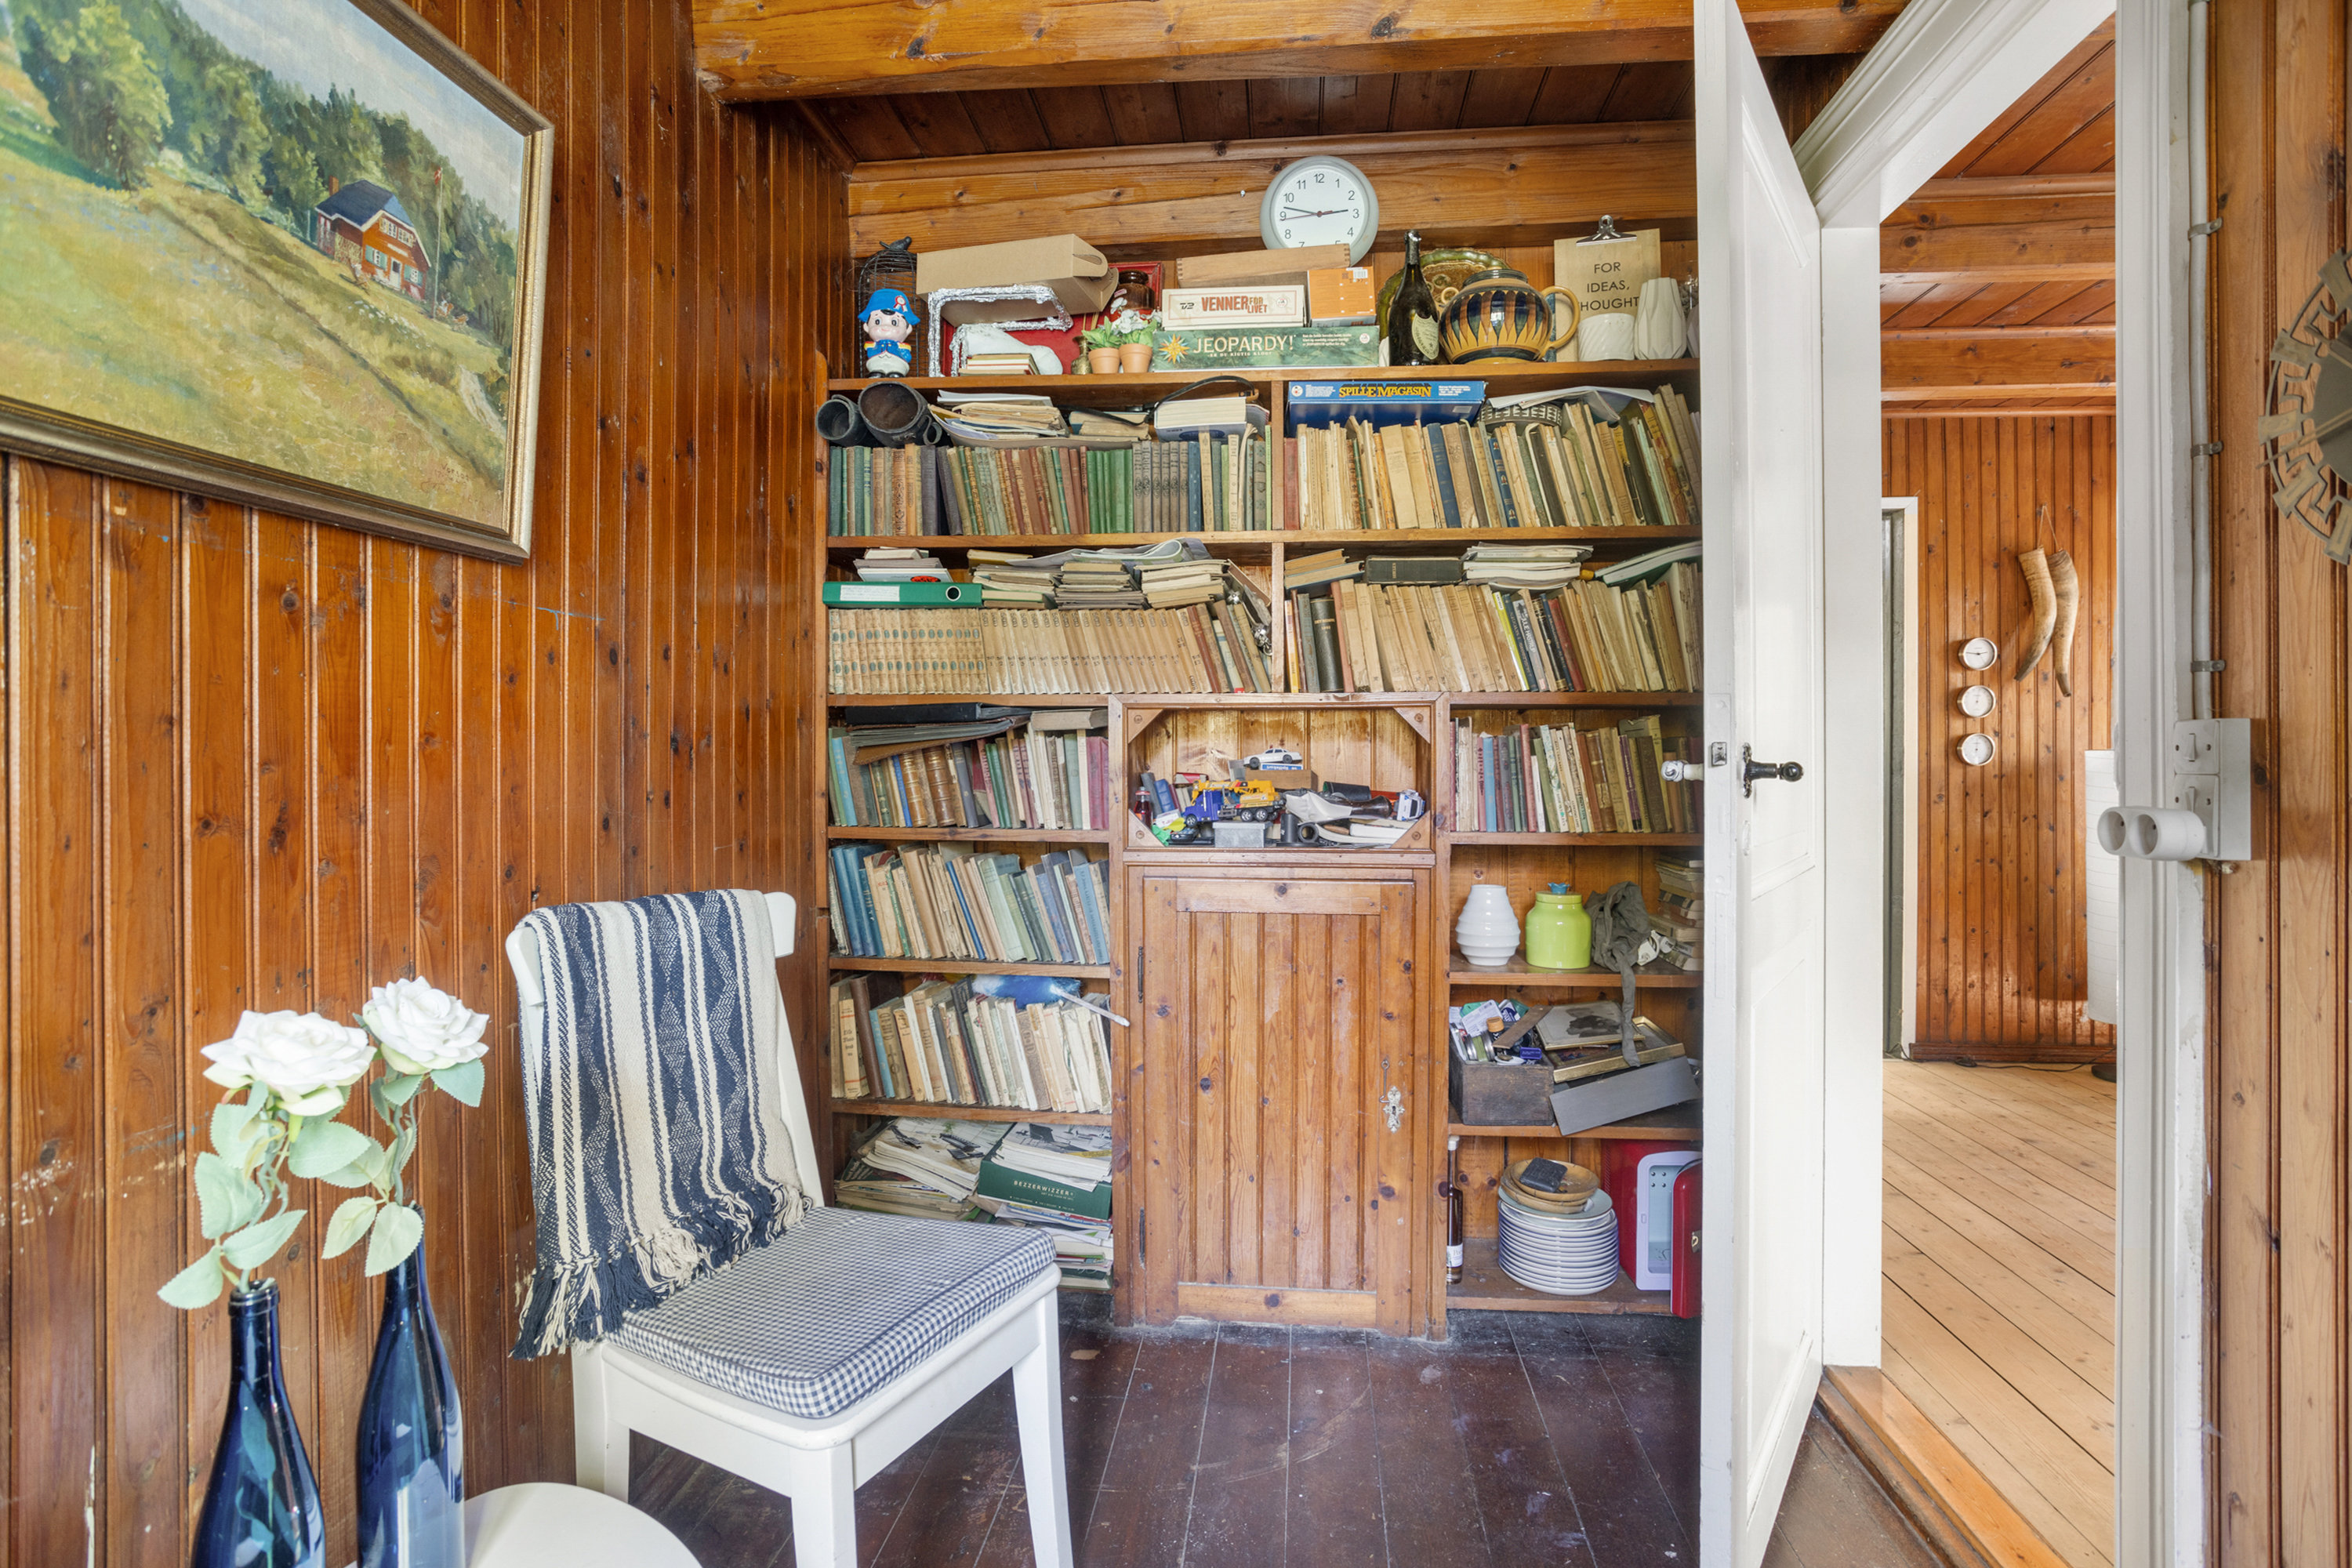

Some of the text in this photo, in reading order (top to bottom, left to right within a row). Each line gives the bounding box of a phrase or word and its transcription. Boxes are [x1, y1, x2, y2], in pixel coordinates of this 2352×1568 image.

[1314, 173, 1325, 183] 12
[1335, 178, 1340, 188] 1
[1296, 180, 1306, 190] 11
[1283, 192, 1294, 203] 10
[1348, 191, 1355, 201] 2
[1279, 211, 1287, 221] 9
[1352, 209, 1359, 219] 3
[1284, 229, 1291, 239] 8
[1347, 227, 1354, 237] 4
[1594, 262, 1621, 274] FOR
[1587, 280, 1630, 293] IDEAS,
[1201, 295, 1263, 312] VENNER FOR
[1578, 296, 1639, 311] HOUGHT
[1247, 304, 1268, 314] LIVET
[1193, 335, 1294, 354] JEOPARDY!
[1339, 384, 1377, 397] SPILLE
[1377, 384, 1432, 397] MAGASIN
[1013, 1180, 1070, 1196] BEZZERWIZZER
